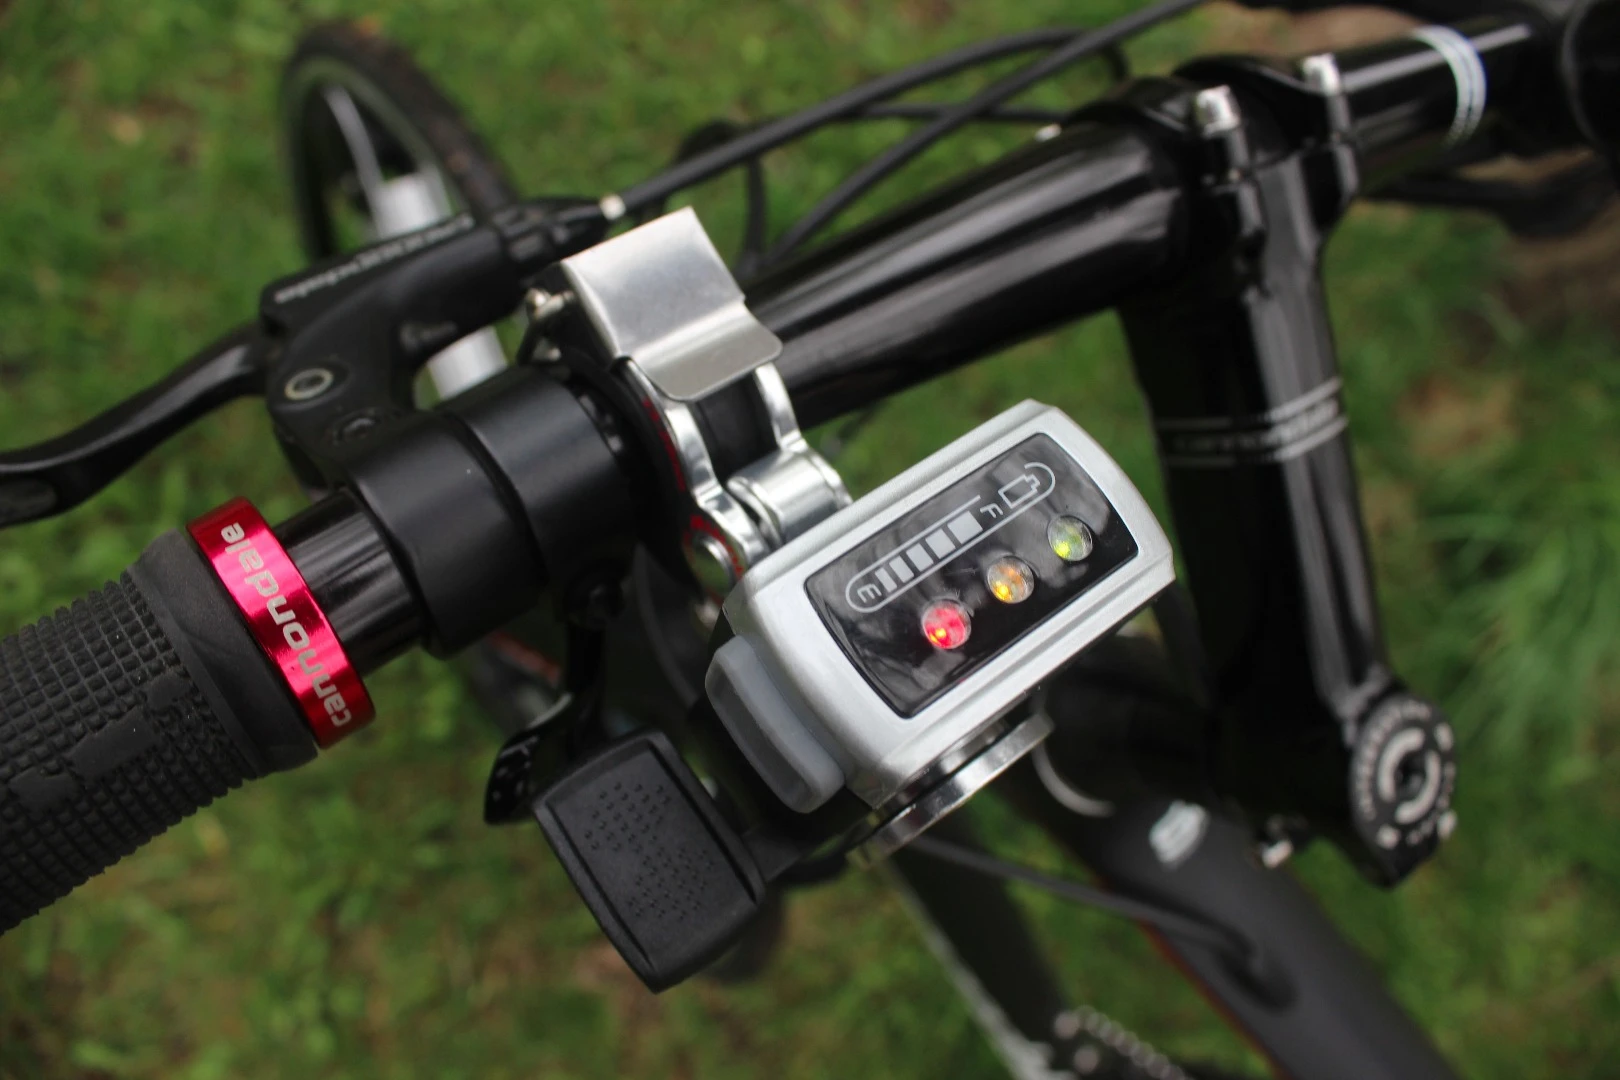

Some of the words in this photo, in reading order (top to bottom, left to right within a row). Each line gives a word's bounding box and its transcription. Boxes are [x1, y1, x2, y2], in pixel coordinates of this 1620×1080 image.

[979, 503, 1003, 519] F
[857, 583, 882, 603] E
[220, 522, 352, 727] cannondale
